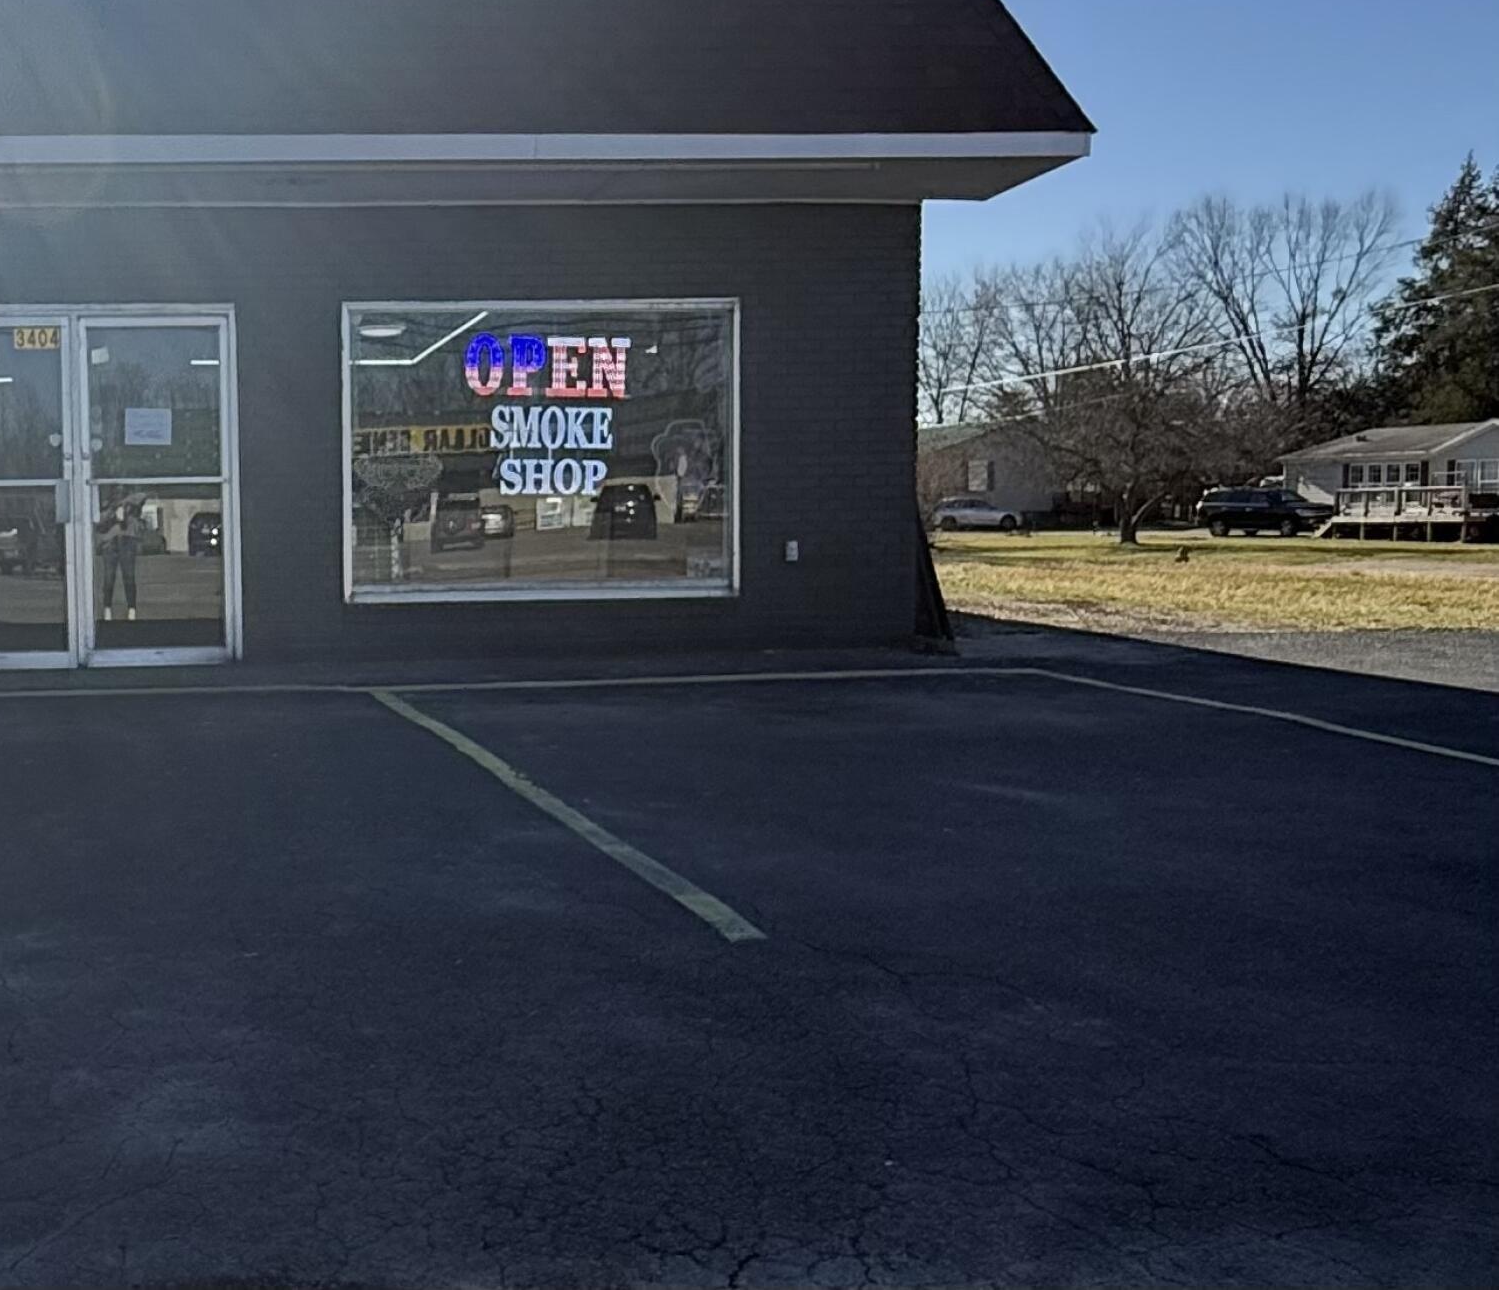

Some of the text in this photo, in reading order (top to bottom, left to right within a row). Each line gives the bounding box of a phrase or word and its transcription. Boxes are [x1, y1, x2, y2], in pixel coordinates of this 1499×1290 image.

[15, 328, 59, 348] 3404
[464, 333, 631, 398] OPEN
[490, 405, 613, 450] SMOKE
[500, 458, 608, 496] SHOP
